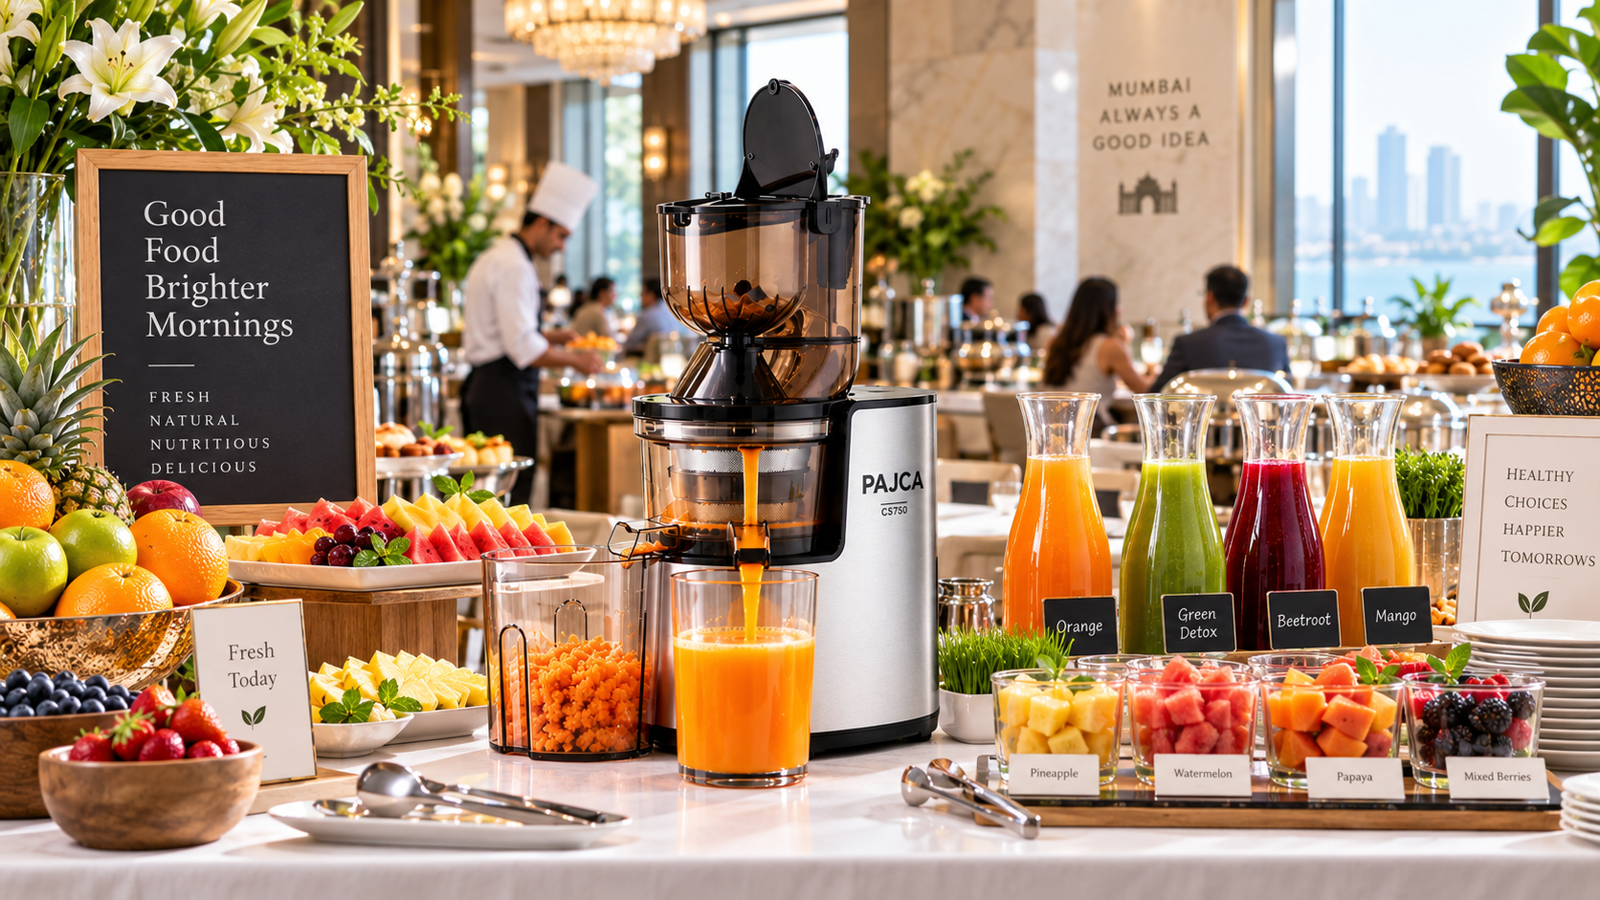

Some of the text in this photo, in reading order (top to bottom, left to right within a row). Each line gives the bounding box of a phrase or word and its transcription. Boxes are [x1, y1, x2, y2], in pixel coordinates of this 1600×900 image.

[1108, 78, 1191, 97] MUMBAI
[1099, 104, 1201, 124] ALWAYS A
[1092, 131, 1209, 151] GOOD IDEA
[143, 199, 227, 227] Good
[144, 236, 220, 264] Food
[145, 272, 270, 308] Brighter
[146, 311, 294, 346] Mornings
[149, 391, 209, 403] FRESH
[150, 414, 239, 427] NATURAL
[150, 437, 270, 451] NUTRITIOUS
[151, 460, 257, 475] DELICIOUS
[1506, 467, 1574, 483] HEALTHY
[862, 470, 925, 495] PAJCA
[1504, 494, 1568, 511] CHOICES
[1503, 522, 1565, 538] HAPPIER
[1500, 549, 1596, 567] TOMORROWS
[1178, 607, 1217, 623] Green
[1277, 612, 1332, 628] Beetroot
[1375, 609, 1417, 626] Mango
[1056, 619, 1104, 635] Orange
[1180, 625, 1218, 640] Detox
[228, 641, 275, 661] Fresh
[227, 669, 278, 691] Today
[1030, 767, 1079, 781] Pineapple
[1173, 768, 1233, 779] Watermelon
[1336, 771, 1373, 784] Papaya
[1464, 771, 1532, 782] Mixed Berries
